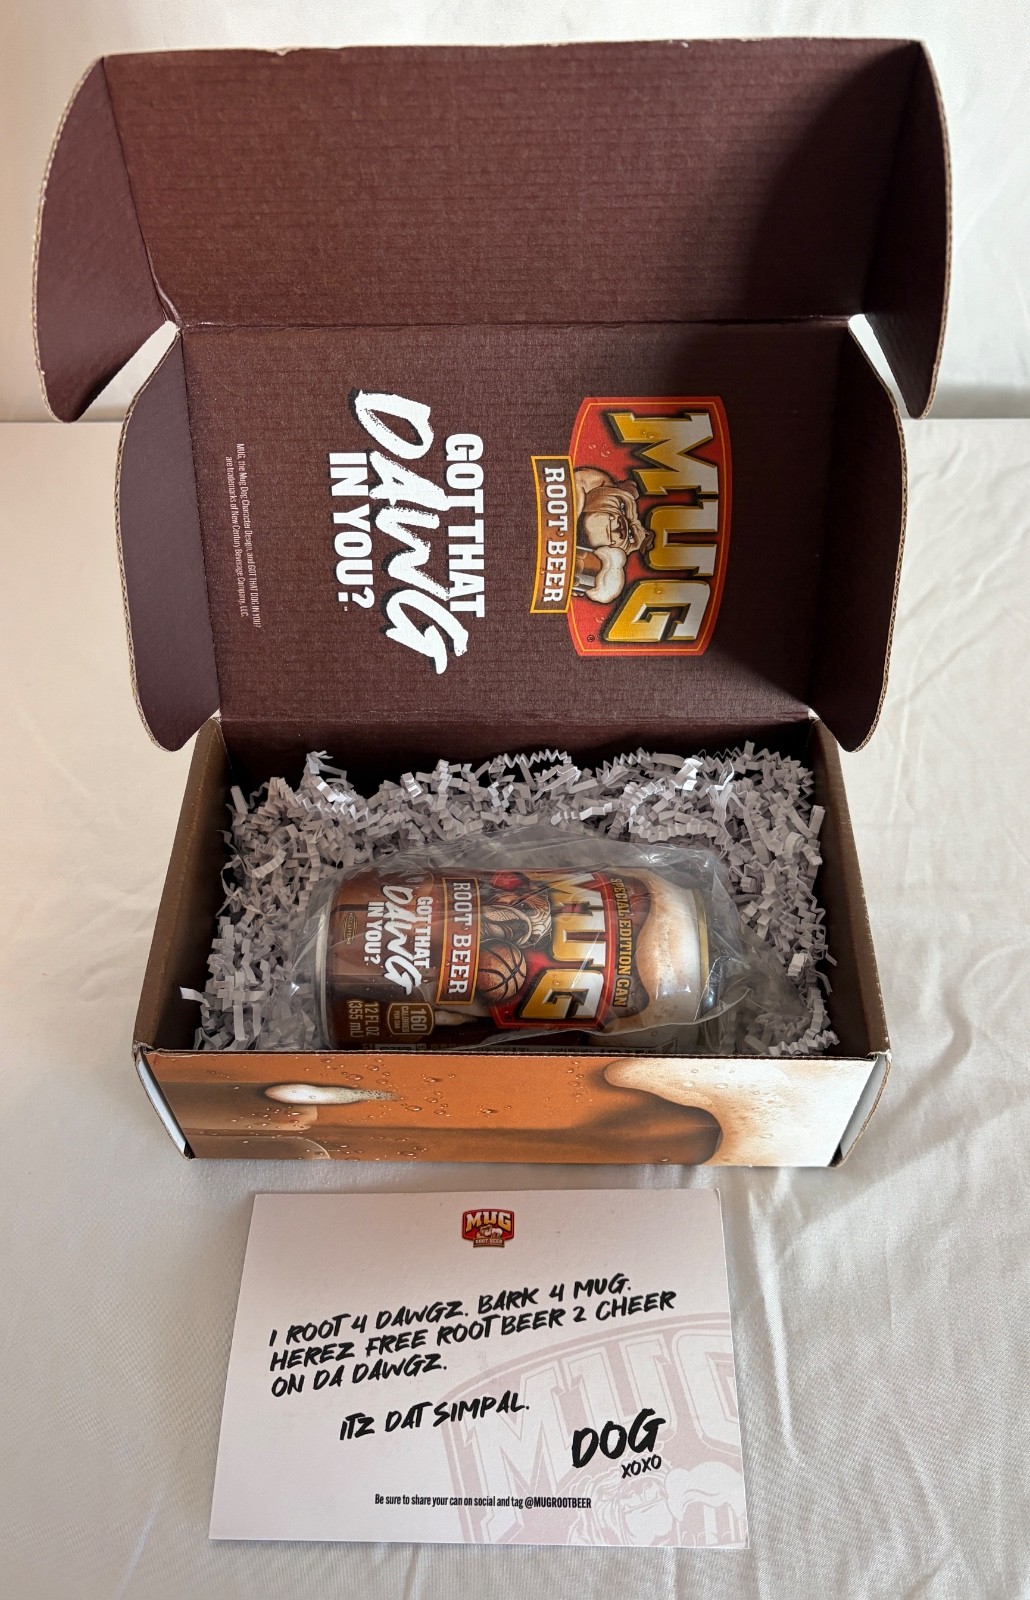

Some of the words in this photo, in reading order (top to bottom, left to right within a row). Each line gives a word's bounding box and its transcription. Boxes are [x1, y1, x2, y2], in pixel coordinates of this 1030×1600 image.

[225, 456, 233, 466] are
[236, 443, 246, 460] MUG,
[238, 460, 246, 472] the
[226, 467, 238, 503] trademarks
[239, 472, 248, 486] Mug
[329, 452, 369, 498] IN
[445, 433, 484, 513] GOT
[240, 486, 249, 499] Dog
[543, 467, 568, 531] ROOT
[231, 510, 240, 524] New
[241, 500, 252, 529] Character
[606, 411, 719, 642] MUG
[232, 524, 241, 548] Century
[355, 389, 469, 675] DAWG
[234, 548, 244, 577] Beverage
[246, 552, 256, 564] and
[247, 564, 257, 576] GOT
[333, 503, 375, 609] YOU?
[447, 519, 485, 618] THAT
[248, 577, 259, 592] THAT
[543, 540, 568, 603] BEER
[250, 592, 260, 605] DOG
[252, 613, 262, 628] YOU?
[367, 901, 385, 918] IN
[416, 896, 433, 924] GOT
[452, 882, 473, 926] ROOT
[611, 878, 630, 917] SPECIAL
[364, 919, 383, 965] YOU?
[382, 884, 422, 996] DAWG
[413, 924, 431, 969] THAT
[520, 872, 607, 1019] MUG
[618, 919, 632, 976] EDITION
[448, 934, 472, 994] BEER
[613, 977, 631, 1007] CAN
[347, 999, 364, 1020] (355
[364, 1002, 379, 1014] 12
[364, 1015, 380, 1026] FL
[401, 1005, 410, 1033] CALORIES
[410, 1008, 428, 1031] 160
[349, 1022, 364, 1038] mL)
[365, 1026, 380, 1037] OZ
[465, 1211, 511, 1232] MUG
[269, 1328, 278, 1347] I
[285, 1313, 351, 1346] ROOT
[351, 1314, 368, 1334] 4
[375, 1300, 469, 1330] DAWGZ.
[477, 1287, 540, 1315] BARK
[548, 1283, 565, 1302] 4
[573, 1272, 632, 1300] MUG.
[269, 1342, 355, 1372] HEREZ
[365, 1329, 429, 1358] FREE
[436, 1314, 501, 1347] ROOT
[500, 1308, 567, 1336] BEER
[572, 1306, 588, 1323] 2
[595, 1290, 677, 1321] CHEER
[271, 1373, 305, 1398] ON
[312, 1364, 345, 1391] DA
[351, 1353, 448, 1385] DAWGZ.
[339, 1412, 375, 1441] ITZ
[384, 1401, 434, 1433] DAT
[432, 1390, 530, 1428] SIMPAL.
[571, 1407, 667, 1469] DOG
[620, 1454, 662, 1480] XOXO
[374, 1493, 384, 1505] Be
[385, 1496, 402, 1505] sure
[402, 1494, 410, 1505] to
[411, 1494, 432, 1506] share
[432, 1496, 448, 1508] your
[449, 1496, 463, 1506] can
[464, 1497, 473, 1507] on
[473, 1495, 496, 1507] social
[496, 1496, 510, 1507] and
[511, 1497, 524, 1510] tag
[524, 1496, 592, 1510] @MUGROOTBEER
